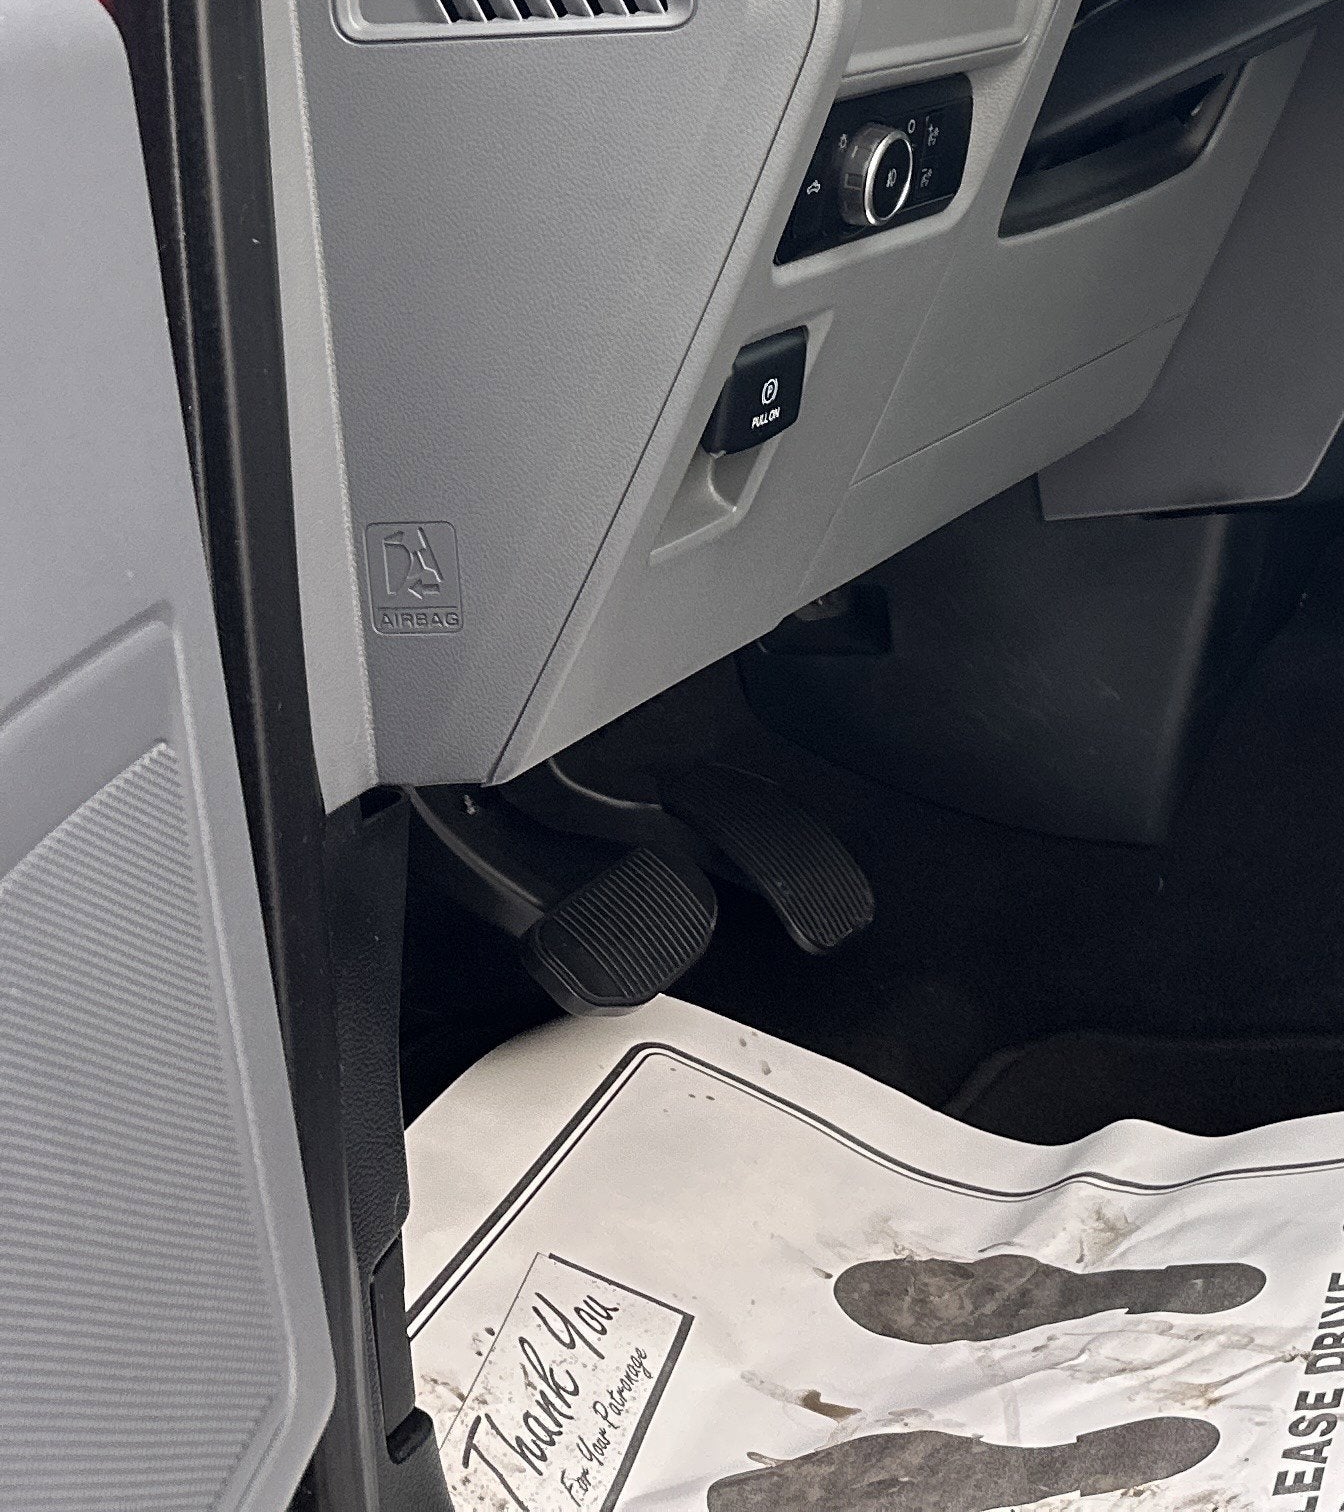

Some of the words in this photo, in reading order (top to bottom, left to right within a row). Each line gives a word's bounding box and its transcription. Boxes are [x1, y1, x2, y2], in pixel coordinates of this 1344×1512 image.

[750, 411, 769, 430] PULL
[768, 406, 781, 422] ON
[381, 611, 460, 629] AIRBAG
[461, 1336, 580, 1512] Thank
[531, 1291, 620, 1360] You
[592, 1346, 654, 1430] Patronage
[575, 1429, 612, 1467] Your
[560, 1467, 590, 1508] For
